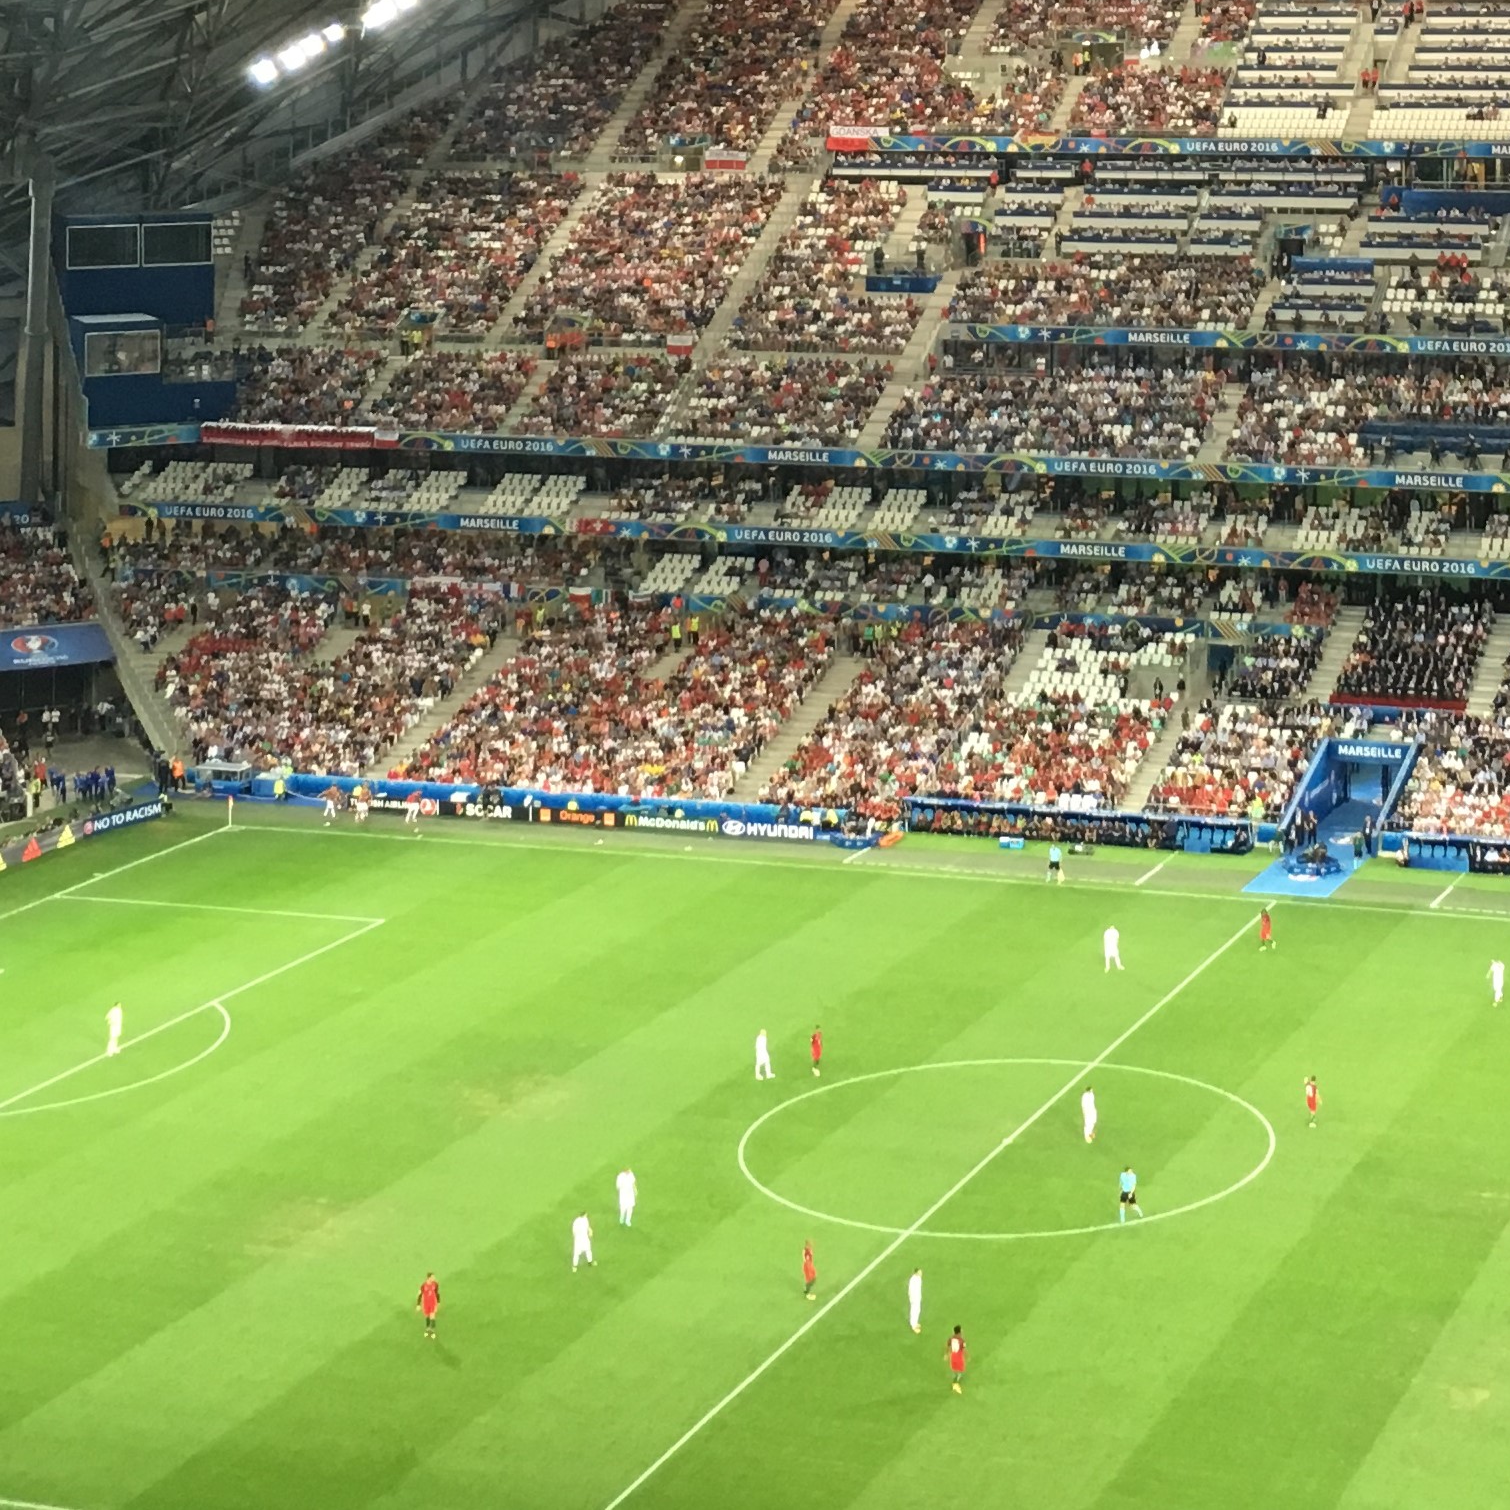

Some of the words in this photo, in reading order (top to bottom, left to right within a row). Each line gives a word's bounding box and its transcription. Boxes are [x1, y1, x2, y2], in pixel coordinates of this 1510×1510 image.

[1186, 142, 1216, 152] UEFA
[1217, 142, 1248, 152] EURO
[1250, 142, 1279, 152] 2016
[1128, 332, 1190, 344] MARSEILLE
[1417, 340, 1450, 351] UEFA
[1452, 341, 1487, 352] EURO
[460, 438, 490, 450] UEFA
[492, 439, 523, 451] EURO
[525, 440, 554, 452] 2016
[767, 449, 829, 463] MARSEILLE
[1054, 461, 1087, 473] UEFA
[1089, 462, 1123, 474] EURO
[1125, 463, 1157, 475] 2016
[1395, 474, 1464, 488] MARSEILLE
[165, 505, 193, 516] UEFA
[195, 506, 224, 517] EURO
[226, 508, 254, 519] 2016
[460, 517, 520, 530] MARSEILLE
[734, 529, 766, 540] UEFA
[768, 530, 800, 542] EURO
[802, 532, 833, 543] 2016
[1060, 543, 1126, 557] MARSEILLE
[1366, 558, 1401, 570] UEFA
[1403, 560, 1439, 572] EURO
[1441, 562, 1476, 574] 2016
[1337, 744, 1402, 759] MARSEILLE
[93, 816, 110, 831] NO
[111, 812, 125, 827] TO
[125, 802, 162, 823] RACISM
[560, 810, 596, 824] Orange
[638, 815, 705, 831] McDonald's
[746, 822, 814, 840] HYUNDAI
